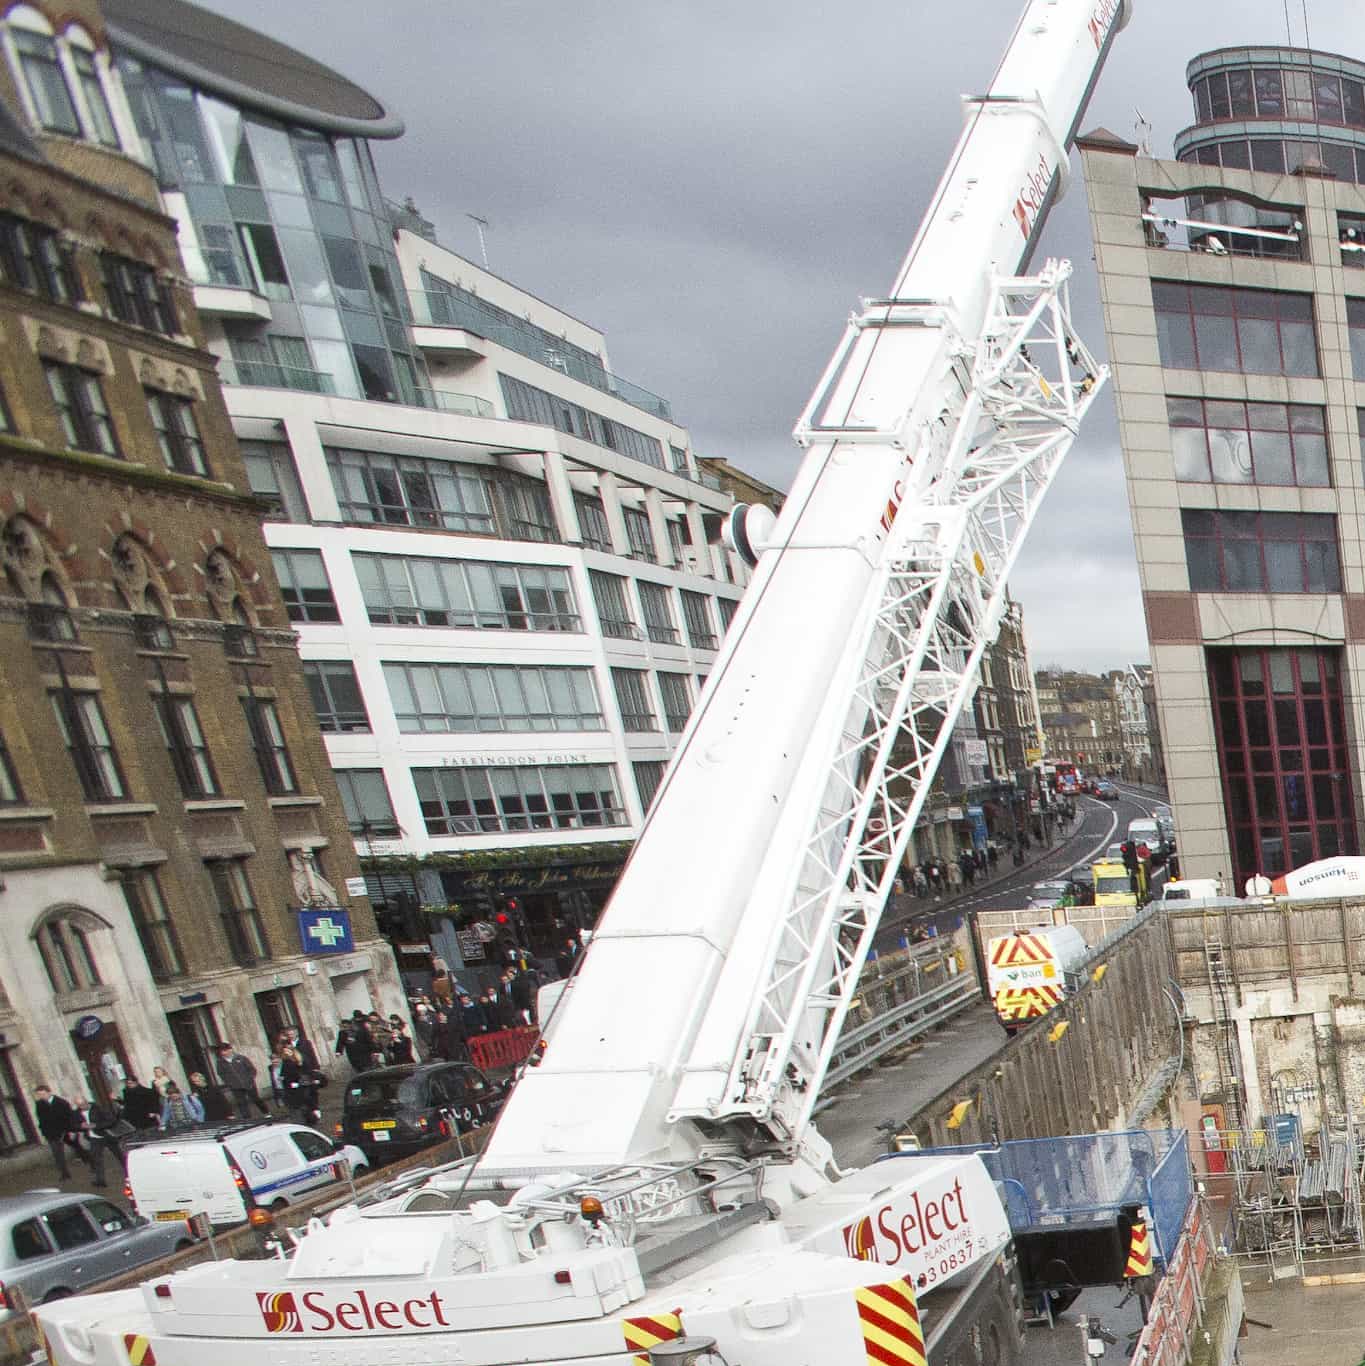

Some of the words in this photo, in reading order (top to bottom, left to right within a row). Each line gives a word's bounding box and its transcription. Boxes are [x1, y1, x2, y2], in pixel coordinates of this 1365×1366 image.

[1019, 152, 1054, 222] Select
[442, 755, 536, 767] FARRINGDON
[547, 753, 589, 764] POINT
[1298, 867, 1347, 887] Hanson
[877, 1175, 968, 1266] Select
[924, 1240, 953, 1262] PLANT
[953, 1228, 974, 1248] HIRE
[940, 1242, 974, 1275] 0837
[302, 1289, 451, 1332] Select
